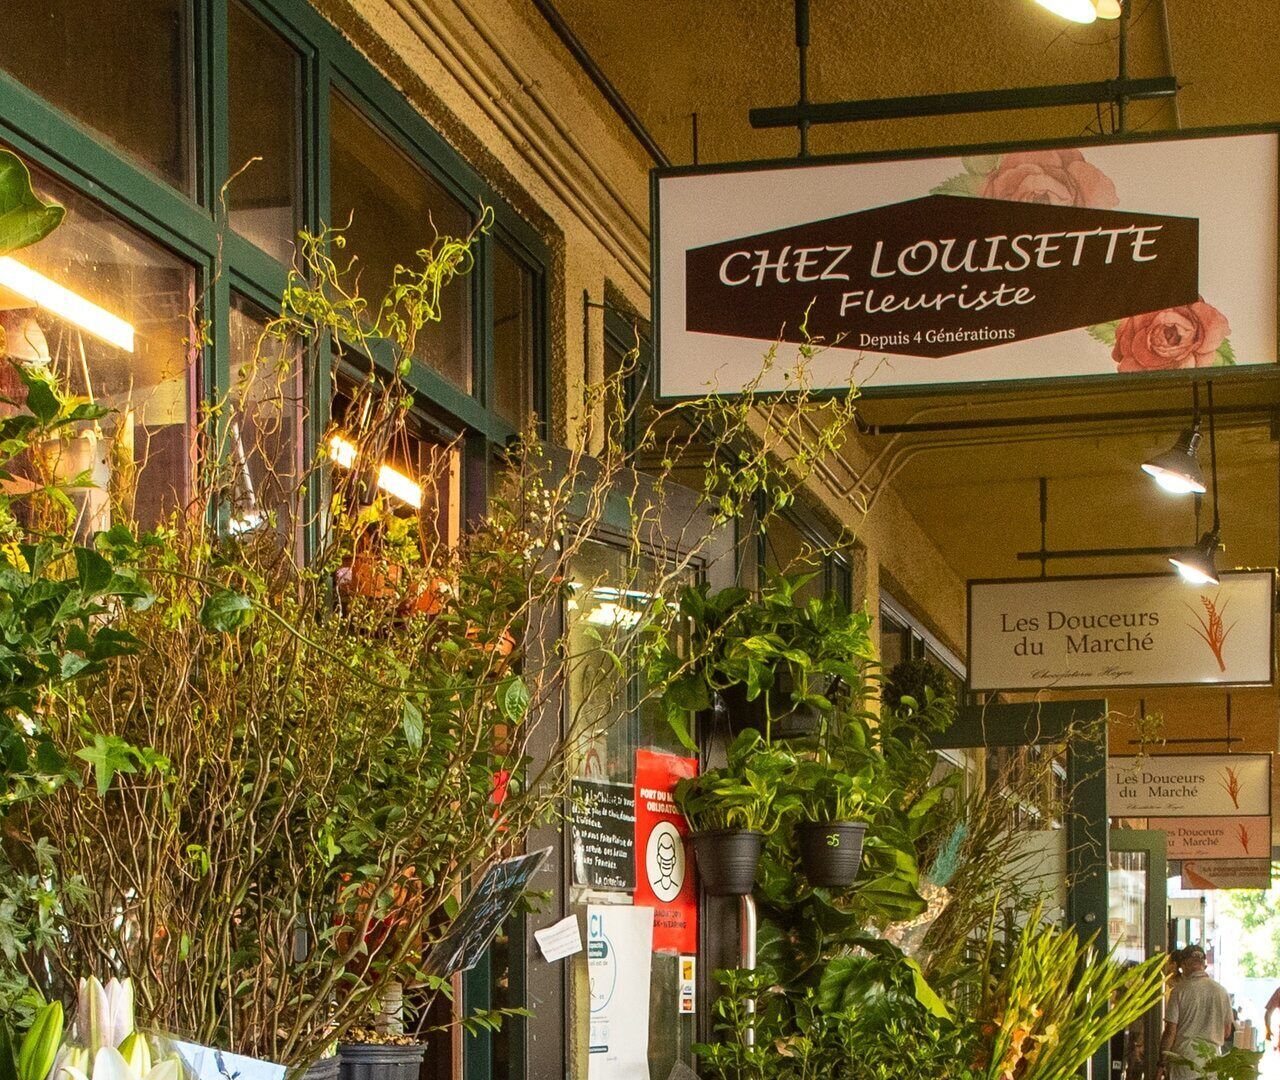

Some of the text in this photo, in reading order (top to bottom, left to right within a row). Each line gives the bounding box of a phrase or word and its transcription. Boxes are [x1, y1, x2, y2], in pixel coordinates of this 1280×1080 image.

[719, 225, 1163, 287] CHEZ LOUISETTE
[839, 283, 1036, 317] Fleuriste
[860, 326, 1015, 349] Depuis 4 Générations
[1000, 609, 1160, 633] Les Douceurs
[1013, 632, 1154, 656] du Marché
[1116, 772, 1205, 785] Les Douceurs
[657, 791, 667, 801] DU
[1119, 786, 1198, 798] du Marché
[1166, 828, 1224, 838] es Douceurs
[1183, 837, 1220, 847] Marché
